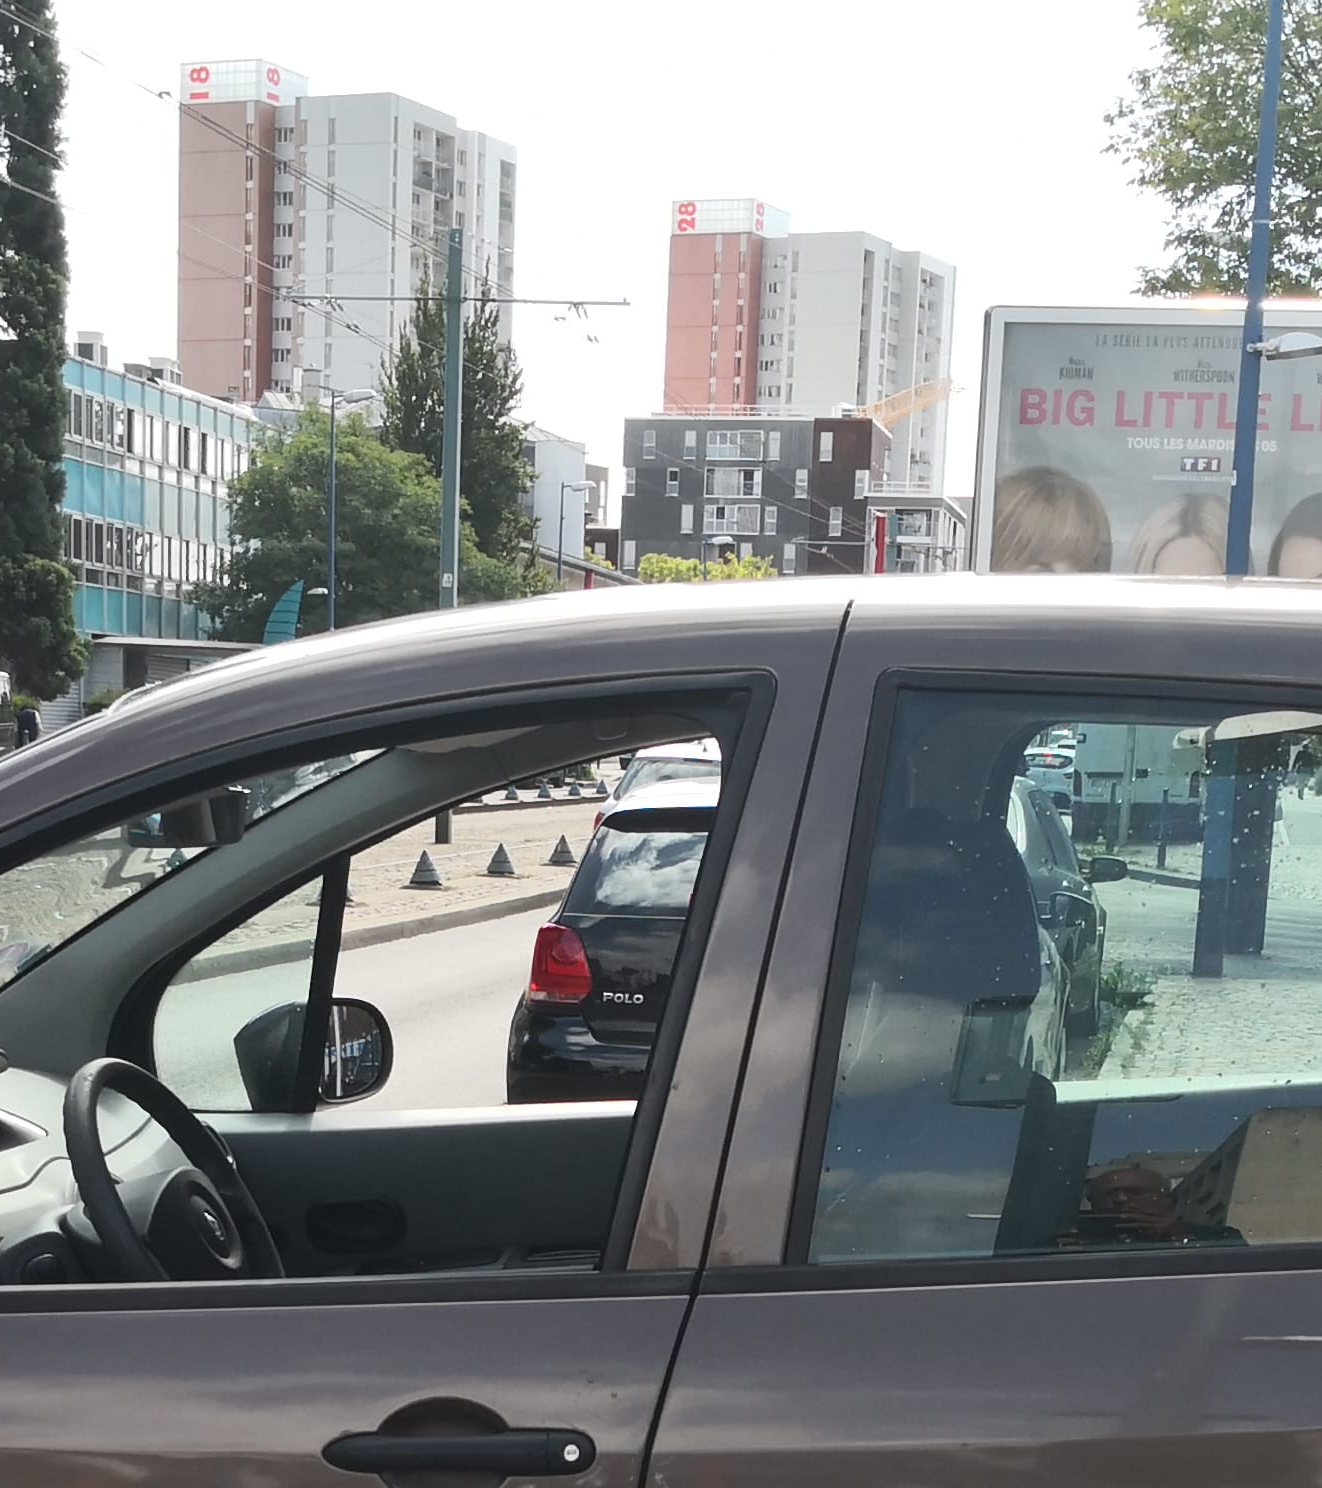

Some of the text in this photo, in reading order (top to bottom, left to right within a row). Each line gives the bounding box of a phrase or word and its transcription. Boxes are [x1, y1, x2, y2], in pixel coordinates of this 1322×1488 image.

[678, 201, 696, 232] 28
[1019, 388, 1095, 427] BIG
[1114, 390, 1270, 432] LITTLE
[1127, 437, 1161, 449] TOUS
[1163, 439, 1184, 449] LES
[1182, 458, 1221, 471] TF1
[603, 992, 644, 1004] POLO
